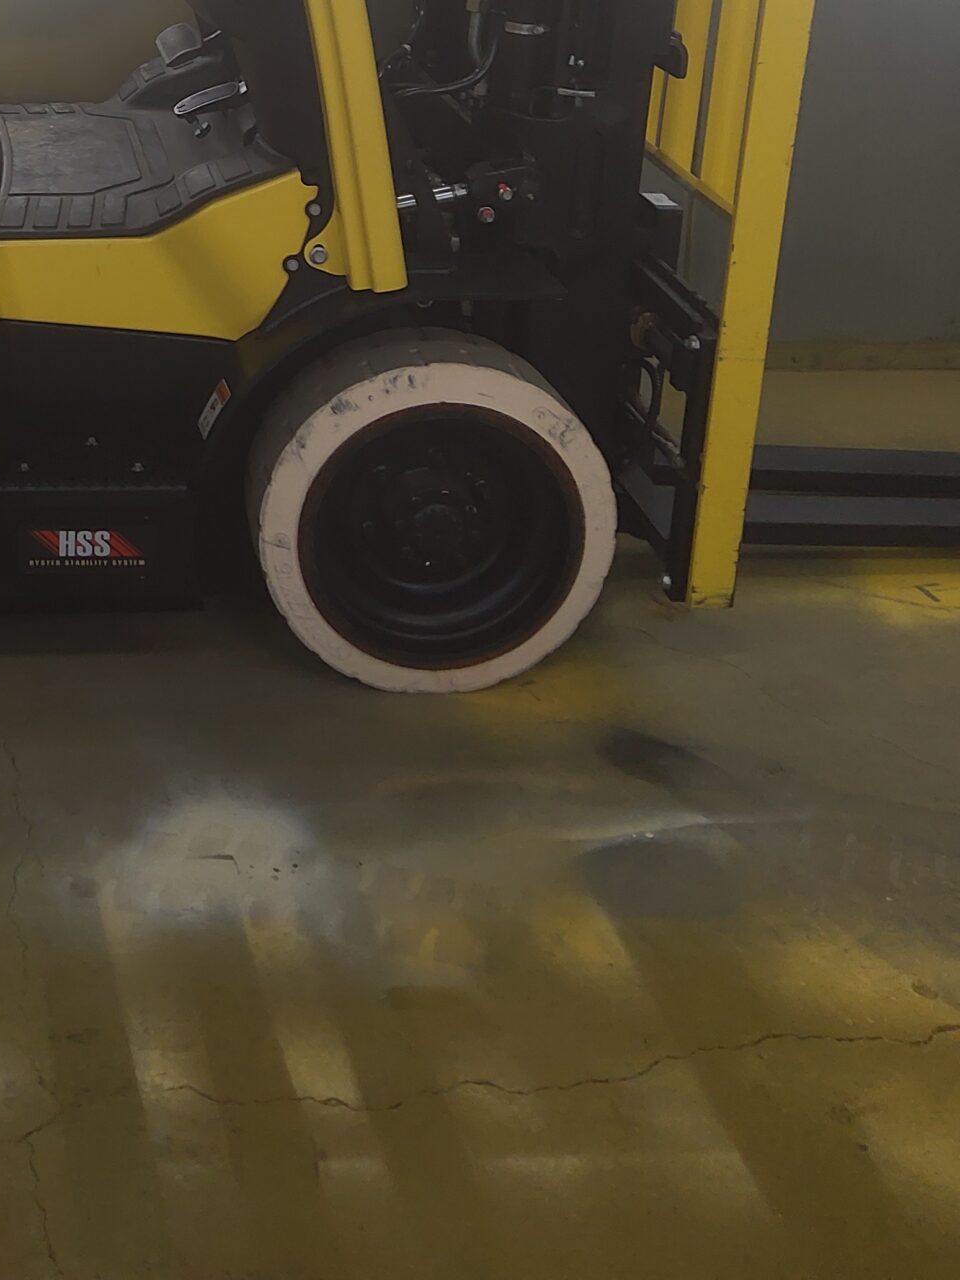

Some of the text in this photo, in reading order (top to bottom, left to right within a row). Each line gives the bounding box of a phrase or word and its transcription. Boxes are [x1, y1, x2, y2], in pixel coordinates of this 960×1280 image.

[58, 530, 111, 557] HSS
[64, 559, 108, 567] STABILITY
[112, 559, 145, 567] SYSTEM
